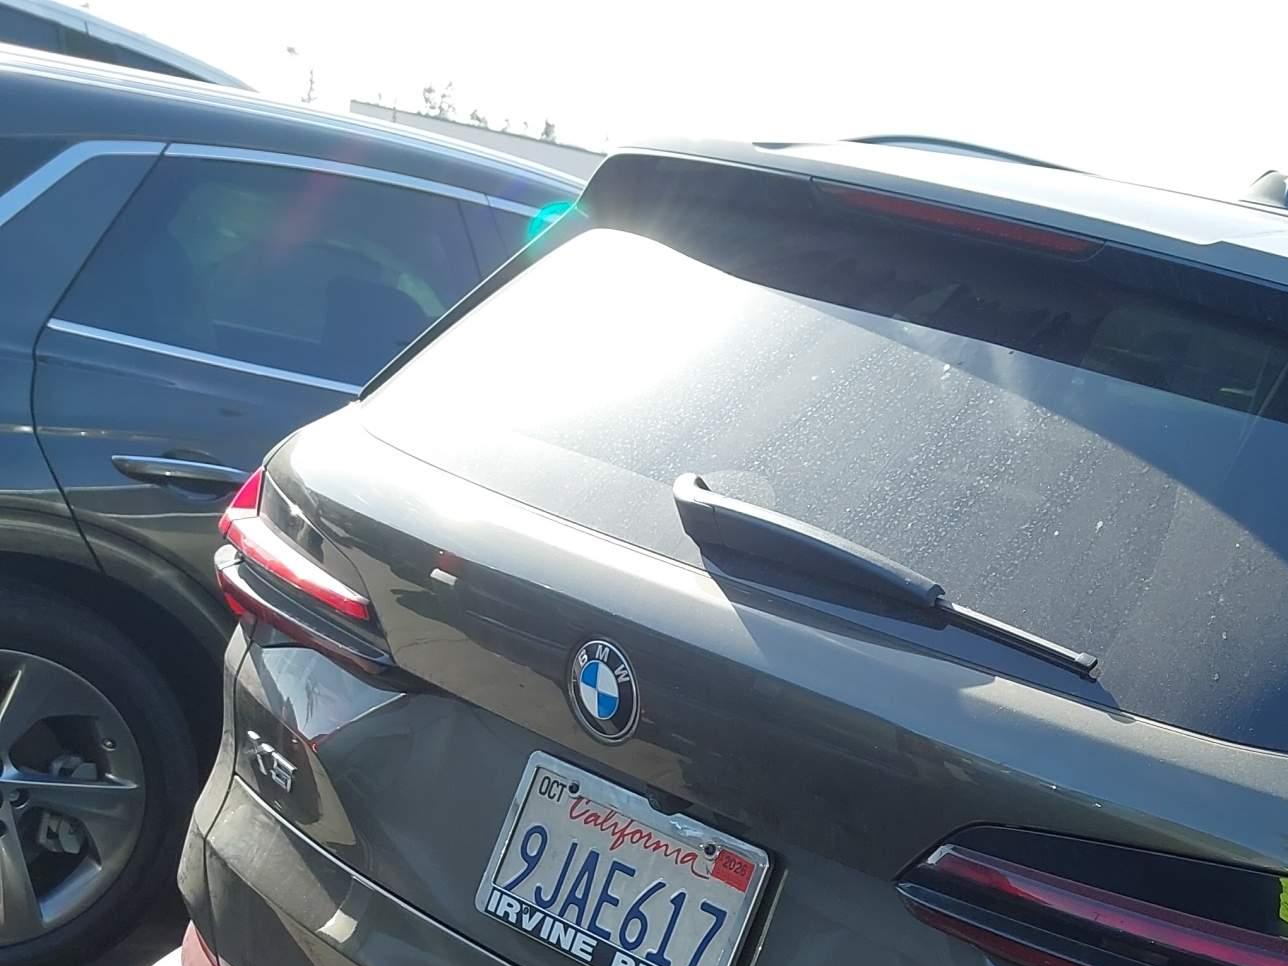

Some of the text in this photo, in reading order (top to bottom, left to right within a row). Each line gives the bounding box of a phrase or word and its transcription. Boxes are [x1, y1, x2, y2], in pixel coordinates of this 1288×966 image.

[578, 645, 629, 684] BMW
[538, 776, 567, 802] OCT
[569, 795, 710, 879] California
[486, 888, 598, 962] IRVINE
